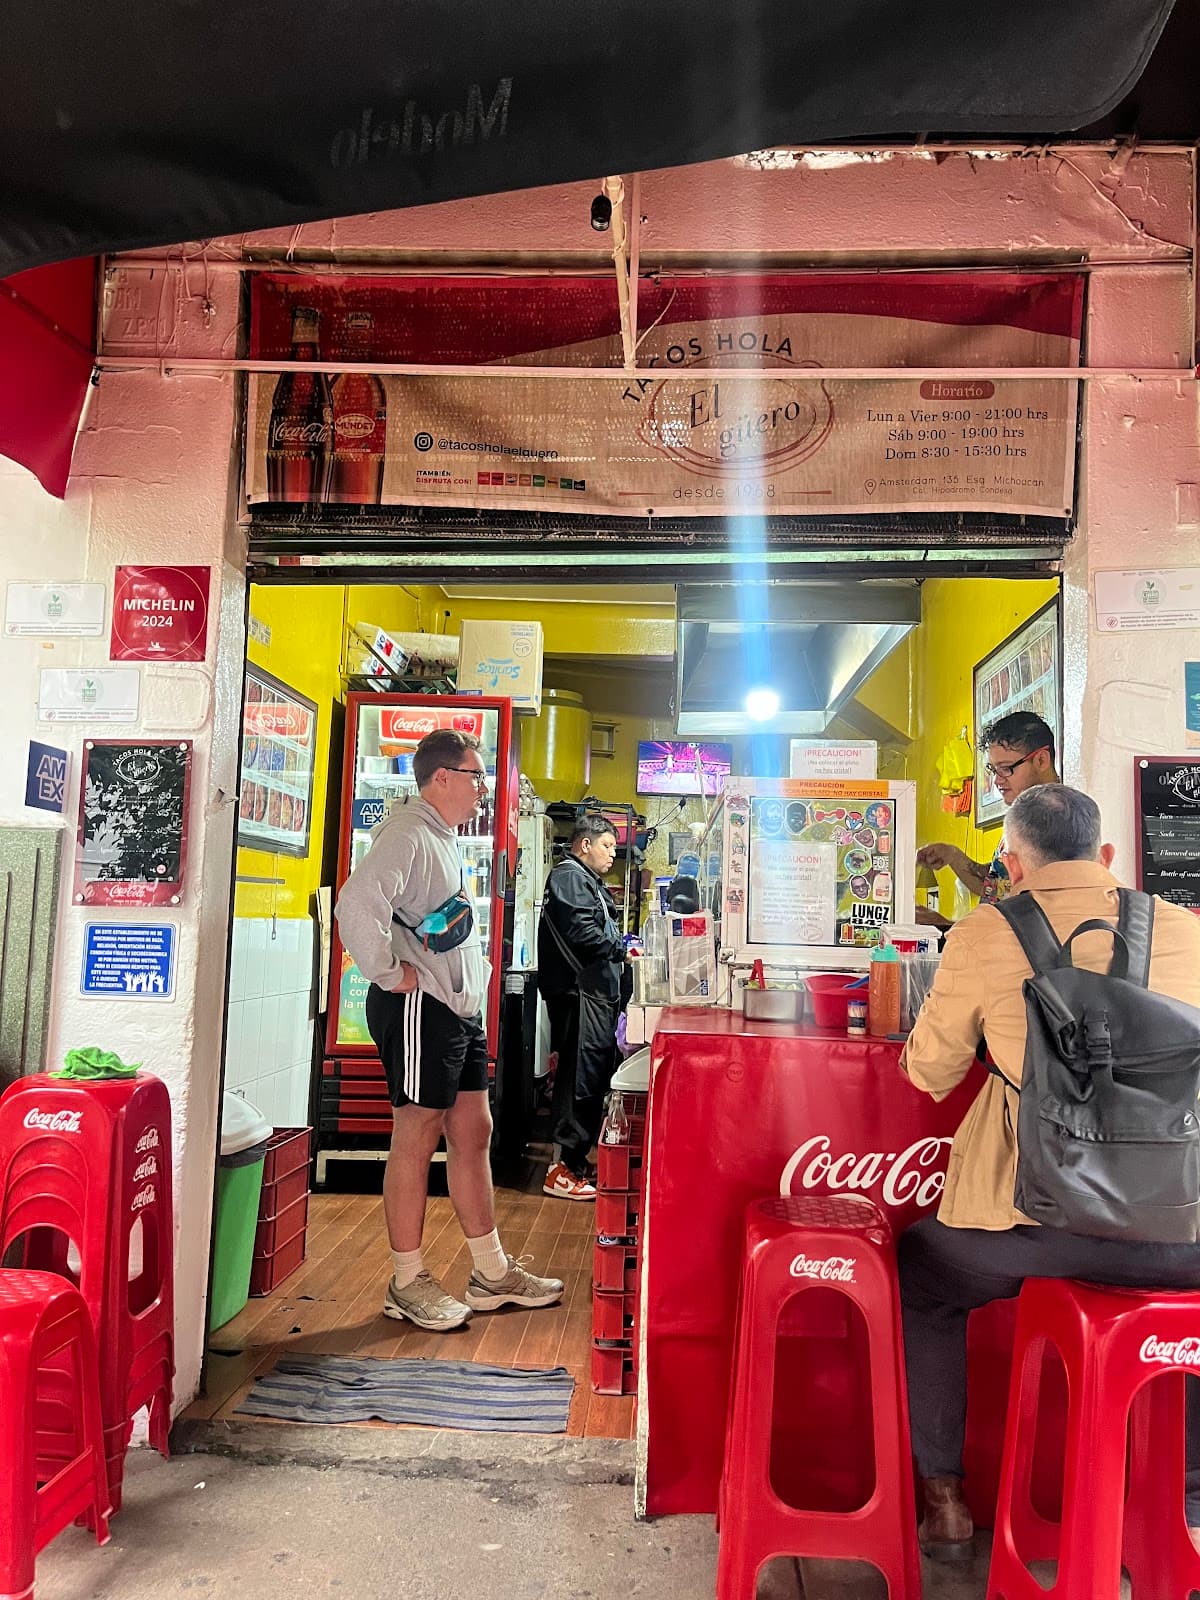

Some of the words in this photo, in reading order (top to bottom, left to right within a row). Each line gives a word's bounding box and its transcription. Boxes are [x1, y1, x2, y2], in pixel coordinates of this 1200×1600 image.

[717, 333, 793, 356] HOLA
[688, 383, 723, 428] El
[867, 409, 893, 422] Lun
[897, 414, 905, 422] a
[911, 409, 938, 422] Vier
[942, 410, 971, 422] 9:00
[984, 408, 1022, 420] 21:00
[1027, 407, 1049, 419] hrs
[275, 422, 329, 442] Coca-Cola
[888, 428, 913, 441] Sáb
[918, 429, 946, 441] 9:00
[961, 427, 998, 439] 19:00
[1002, 426, 1025, 438] hrs
[885, 447, 916, 460] Dom
[921, 447, 950, 458] 8:30
[964, 445, 1001, 457] 15:30
[1005, 445, 1027, 457] hrs
[879, 476, 937, 487] Amsterdam
[673, 484, 725, 499] desde
[123, 599, 195, 611] MICHELIN
[141, 615, 173, 627] 2024
[393, 717, 435, 732] Coca-Cola
[36, 754, 66, 780] AM
[39, 778, 65, 803] EX
[360, 803, 385, 814] AM
[109, 884, 146, 898] Coca-Cola
[852, 903, 890, 920] LUNGZ
[344, 999, 354, 1009] la
[24, 1107, 84, 1132] Coca-Cola
[135, 1127, 160, 1154] Coca-Cola
[133, 1155, 157, 1182] Coca-Cola
[780, 1135, 954, 1207] Coca-Co
[131, 1183, 156, 1211] Coca-Cola
[789, 1253, 857, 1281] Coca-Cola
